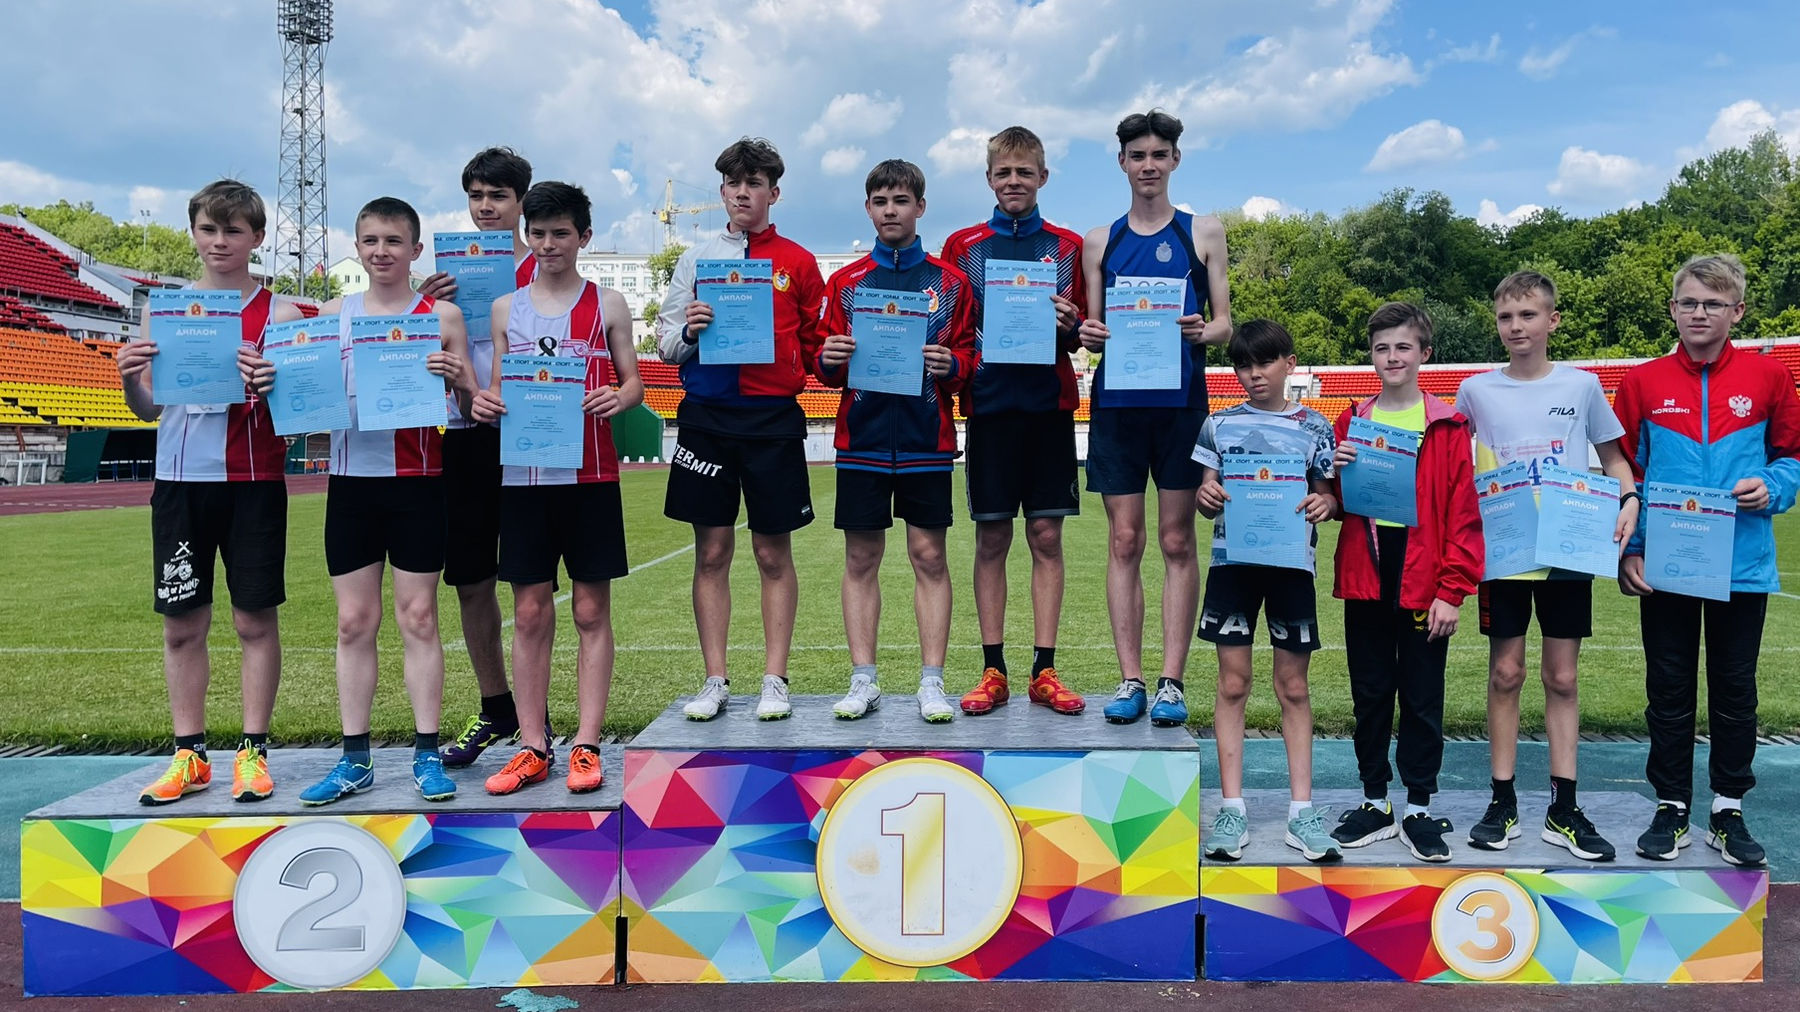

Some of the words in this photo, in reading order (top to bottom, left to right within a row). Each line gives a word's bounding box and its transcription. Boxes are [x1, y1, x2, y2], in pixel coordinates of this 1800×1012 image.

[718, 294, 753, 302] ДИПЛОМ
[873, 325, 907, 333] ДИПЛОМ
[1126, 320, 1161, 329] ДИПЛОМ
[176, 328, 217, 336] ДИПЛОМ
[282, 355, 319, 365] ДИПЛОМ
[379, 353, 418, 362] ДИПЛОМ
[524, 393, 562, 401] ДИПЛОМ
[1549, 407, 1575, 416] FILA
[1361, 457, 1395, 470] ДИПЛОМ
[1246, 492, 1283, 500] ДИПЛОМ
[1484, 501, 1516, 515] ДИПЛОМ
[1562, 499, 1599, 511] ДИПЛОМ
[1670, 521, 1710, 532] ДИПЛОМ
[881, 793, 945, 936] 1
[276, 847, 366, 952] 2
[1456, 889, 1516, 964] 3
